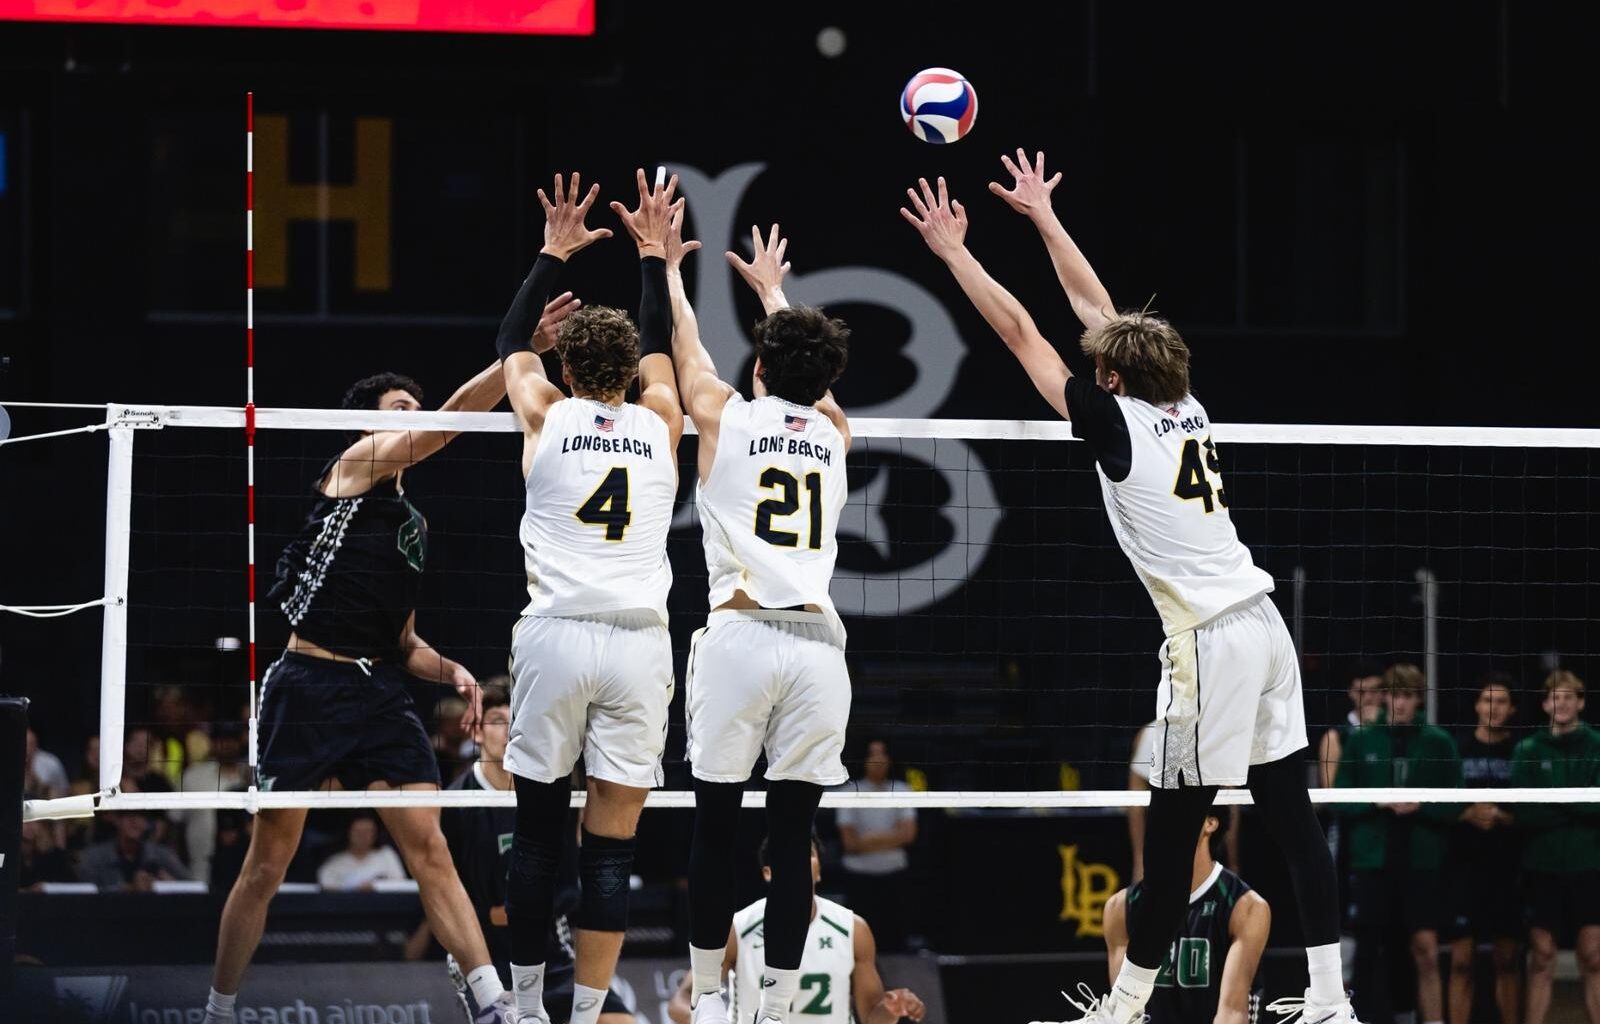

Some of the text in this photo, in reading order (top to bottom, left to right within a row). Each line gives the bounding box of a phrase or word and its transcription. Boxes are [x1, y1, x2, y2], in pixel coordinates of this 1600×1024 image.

[787, 439, 832, 466] BEACH
[573, 466, 632, 542] 4
[753, 465, 823, 551] 21
[236, 999, 320, 1024] each
